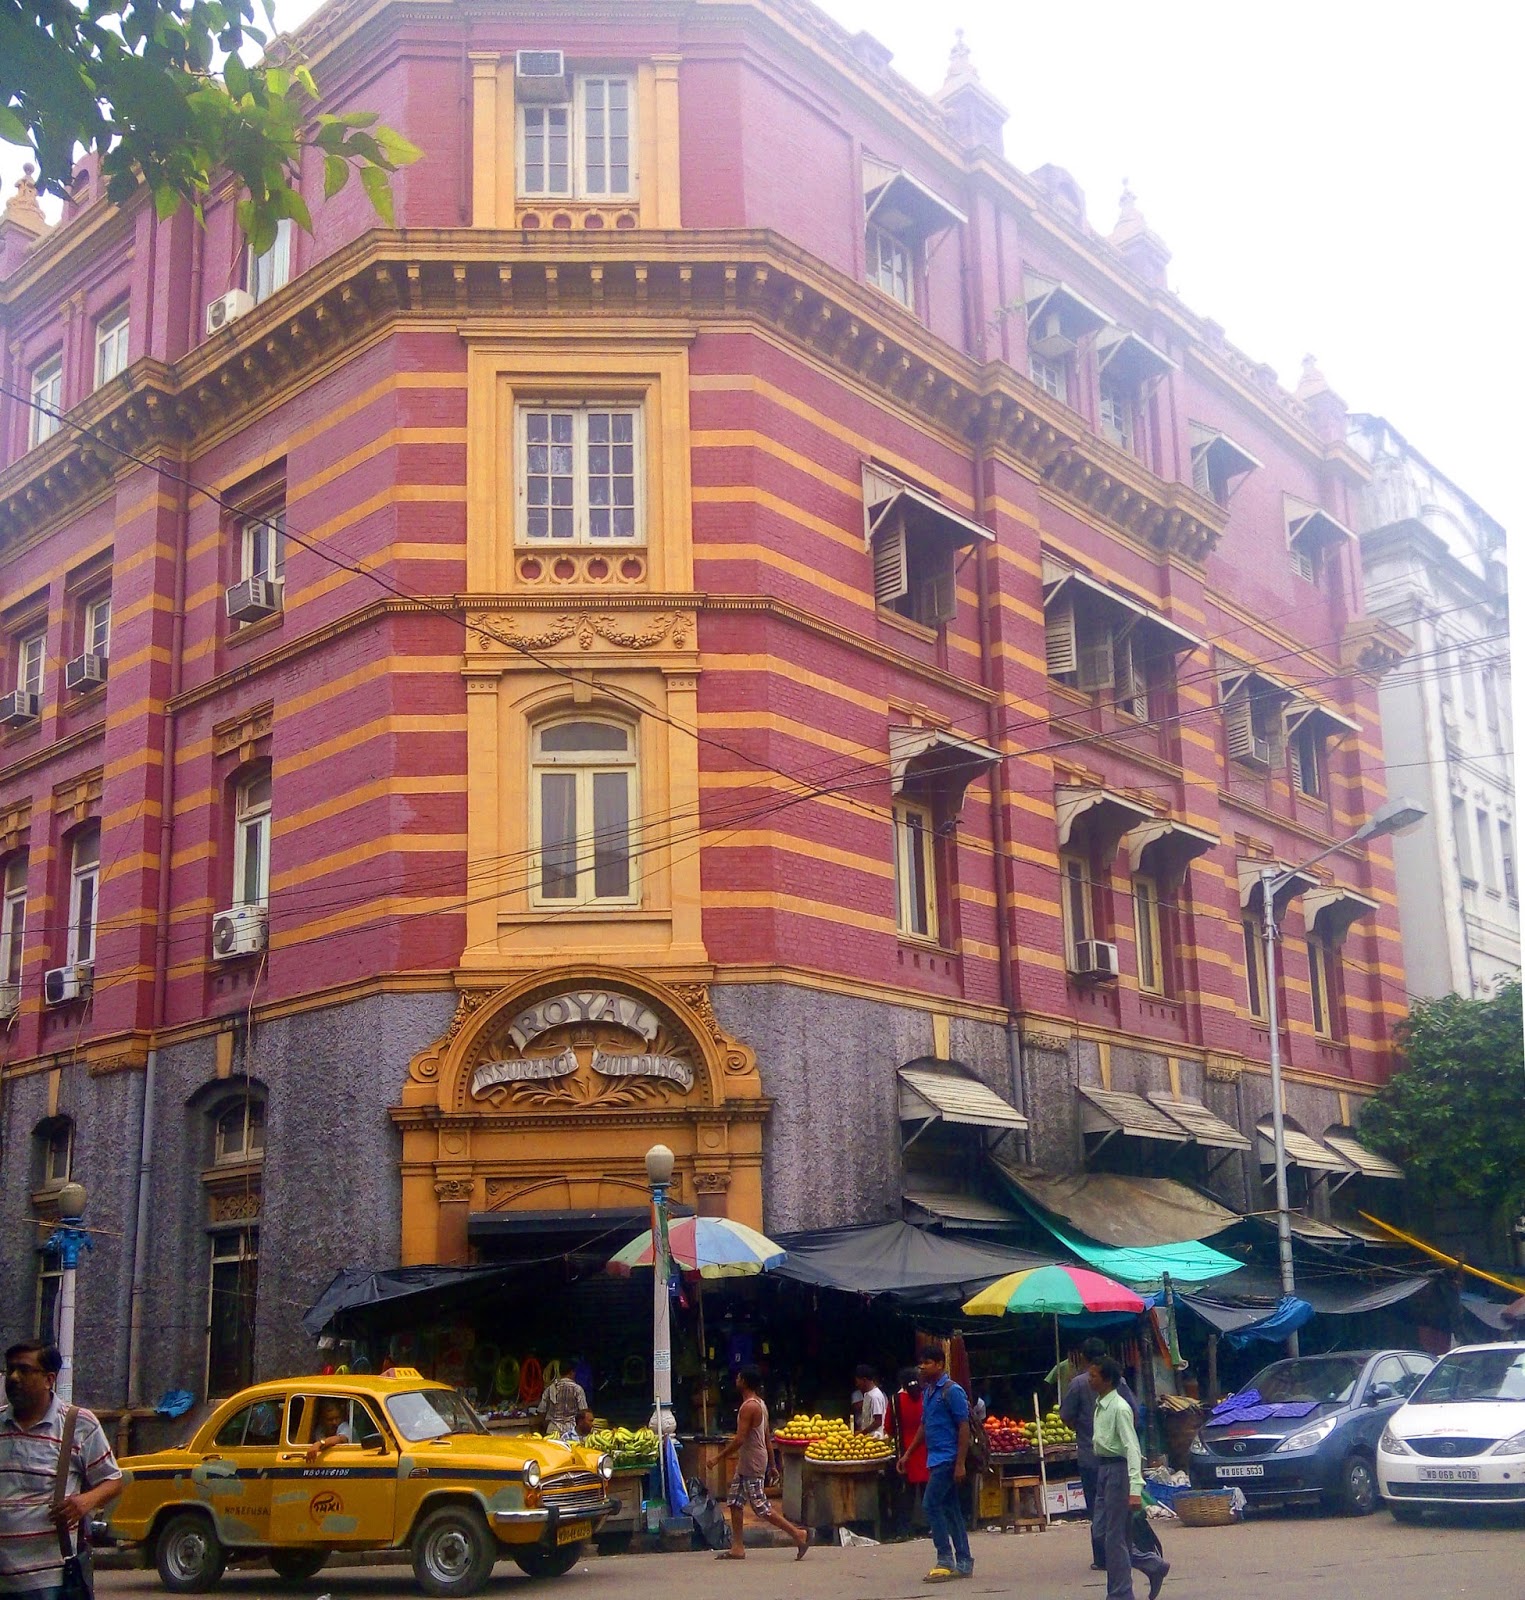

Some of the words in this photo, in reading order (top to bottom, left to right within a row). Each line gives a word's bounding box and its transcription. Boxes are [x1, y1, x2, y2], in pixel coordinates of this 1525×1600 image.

[512, 990, 650, 1041] ROYAL
[475, 1052, 577, 1085] INSURANCE
[595, 1053, 693, 1085] BUILDINGS
[1426, 1470, 1437, 1479] WB
